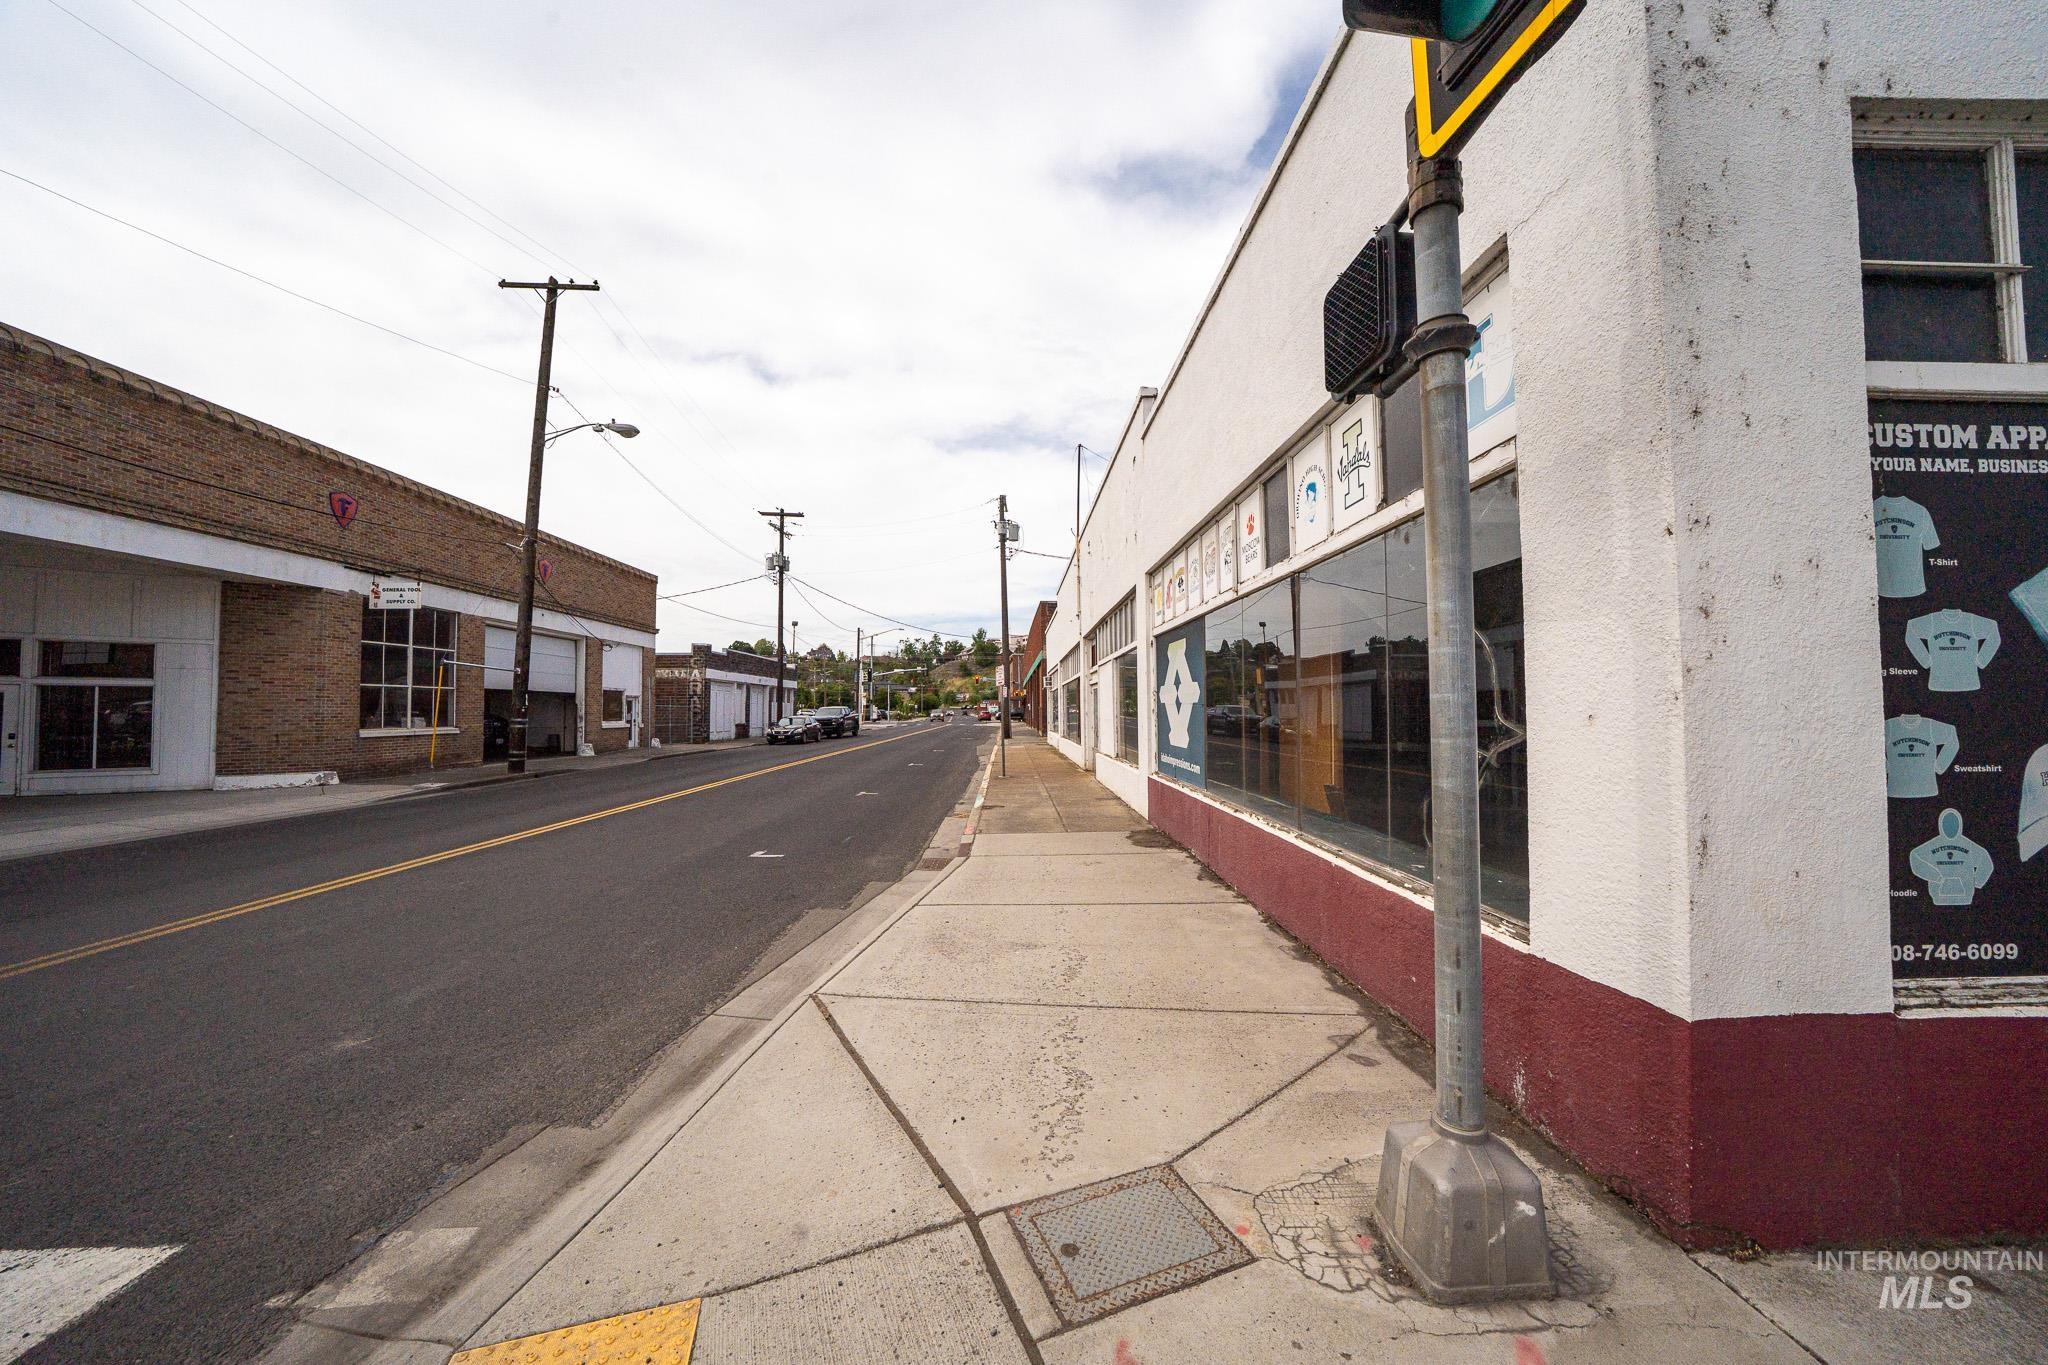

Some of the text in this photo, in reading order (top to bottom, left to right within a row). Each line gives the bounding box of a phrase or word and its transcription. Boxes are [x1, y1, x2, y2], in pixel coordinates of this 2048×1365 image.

[1986, 425, 2048, 450] APP
[1337, 441, 1371, 483] Vandals
[1871, 457, 1916, 472] YOUR
[1920, 458, 1974, 474] NAME,
[1928, 558, 1958, 566] T-Shirt
[1889, 667, 1918, 675] Sleeve
[1954, 764, 2002, 773] Sweatshirt
